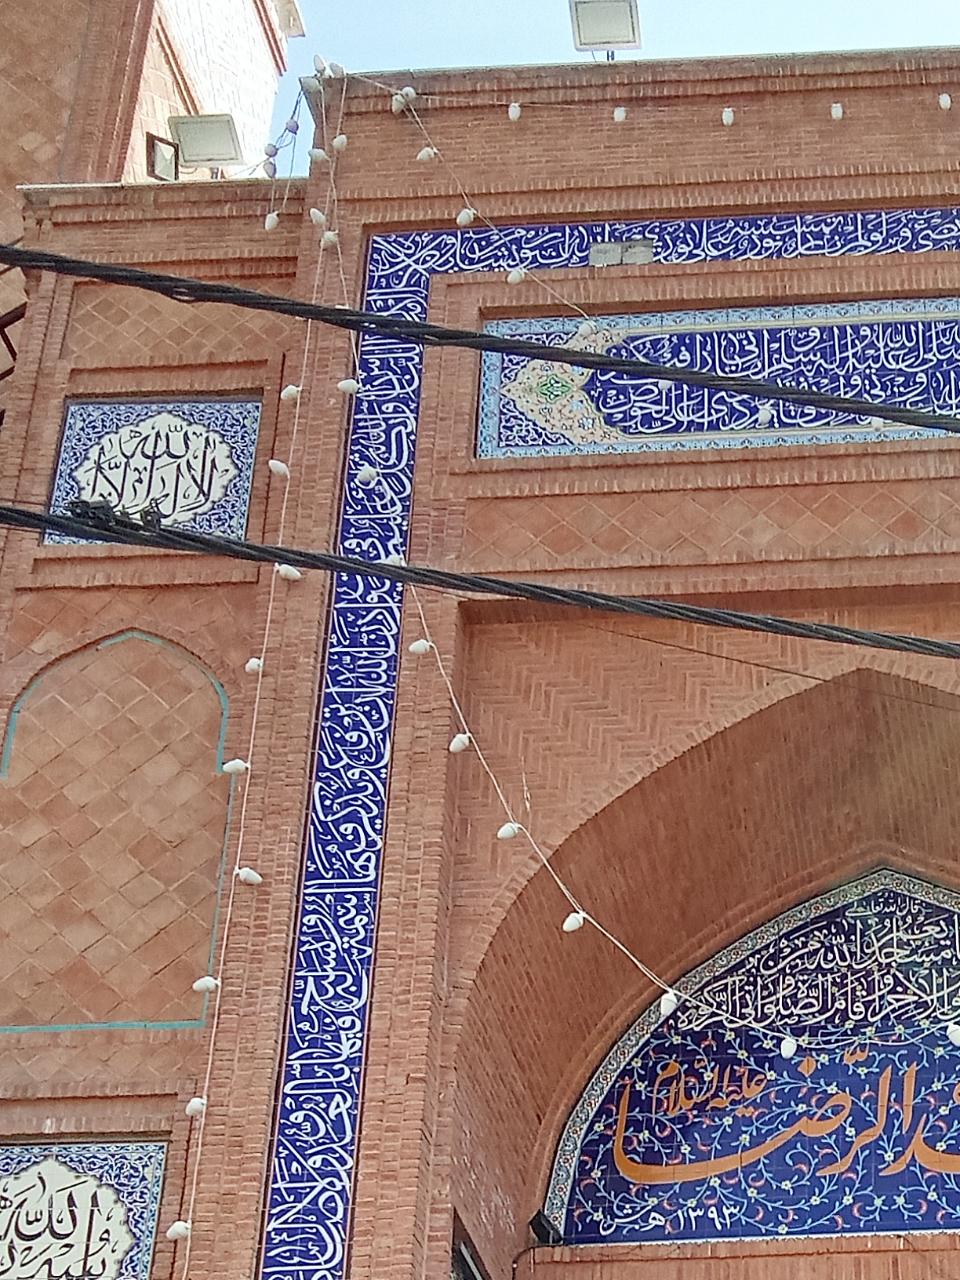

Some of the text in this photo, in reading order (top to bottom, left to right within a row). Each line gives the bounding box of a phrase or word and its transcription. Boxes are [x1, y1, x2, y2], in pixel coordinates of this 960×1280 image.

[612, 1044, 919, 1188] الرضا
[652, 1059, 732, 1127] السلام
[705, 1062, 768, 1118] عليه
